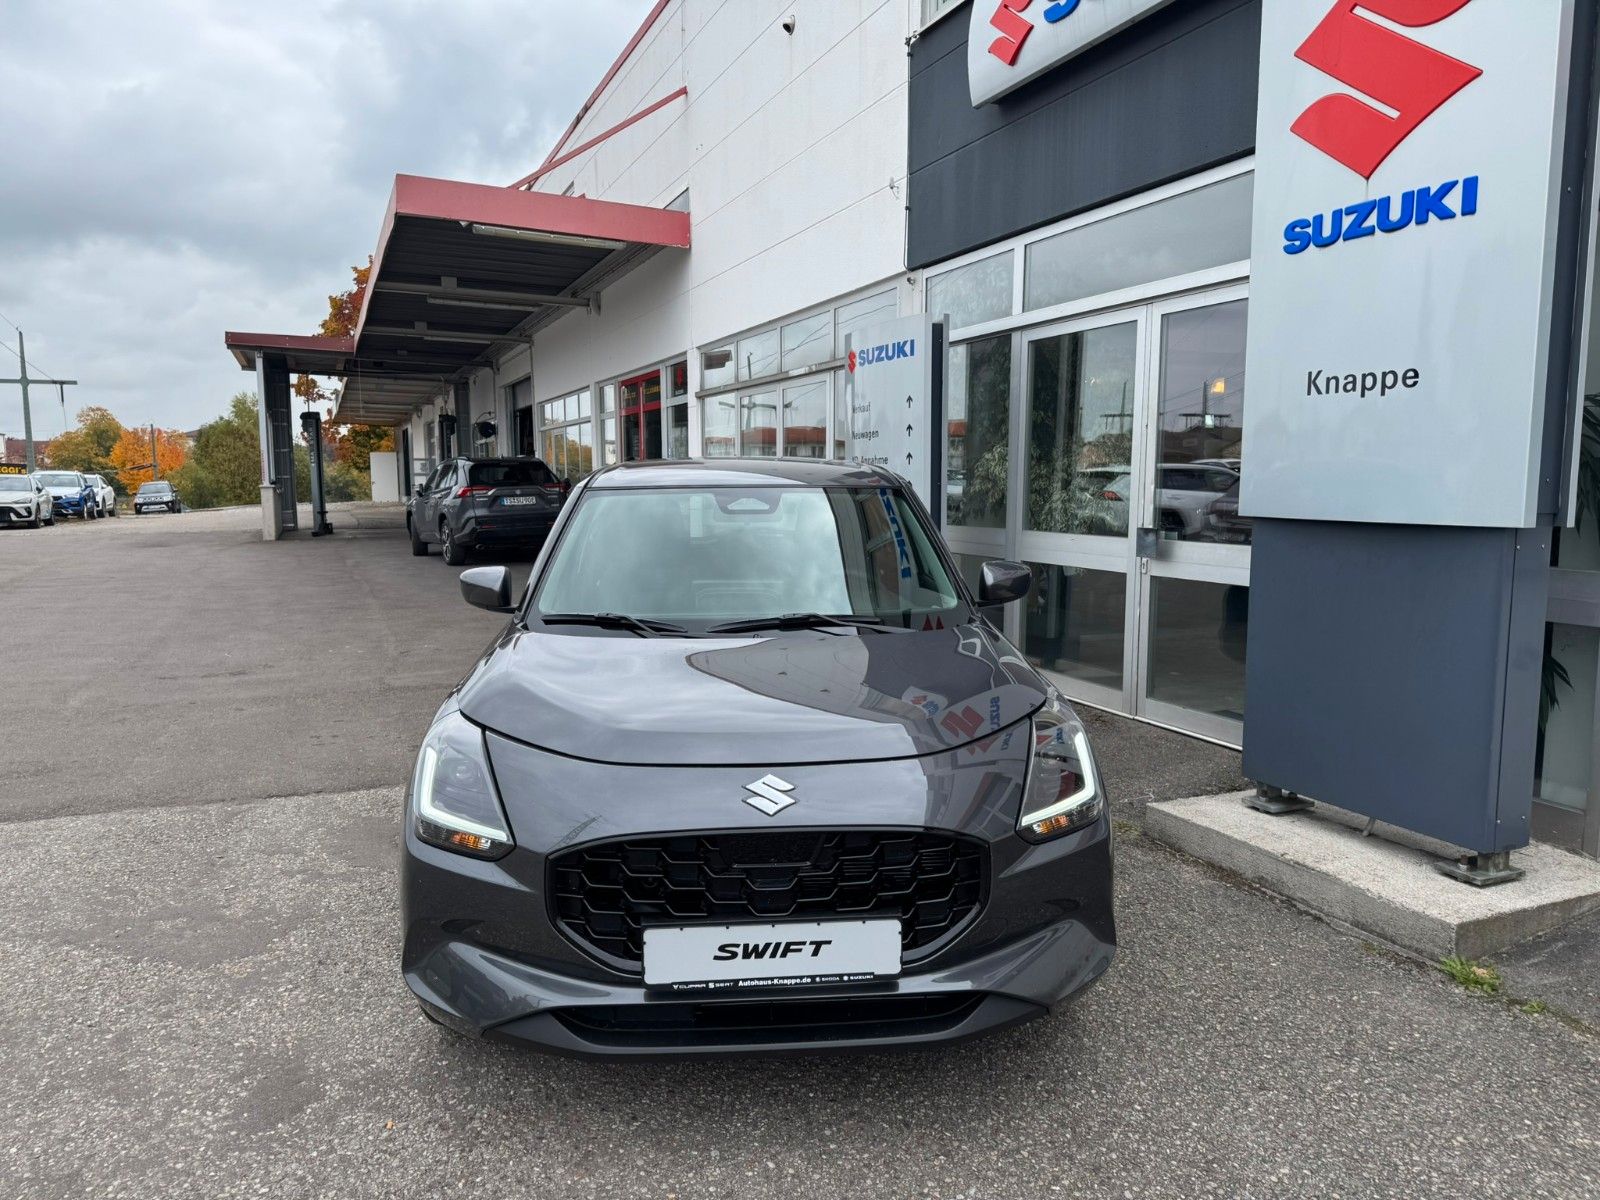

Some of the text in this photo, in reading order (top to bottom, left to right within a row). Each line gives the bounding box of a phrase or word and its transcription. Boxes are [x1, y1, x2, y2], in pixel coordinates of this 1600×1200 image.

[1283, 175, 1479, 255] SUZUKI
[858, 339, 915, 367] SUZUKI
[1307, 367, 1420, 398] Knappe
[713, 940, 832, 961] SWIFT
[738, 976, 812, 988] Autohaus-Knappe.de
